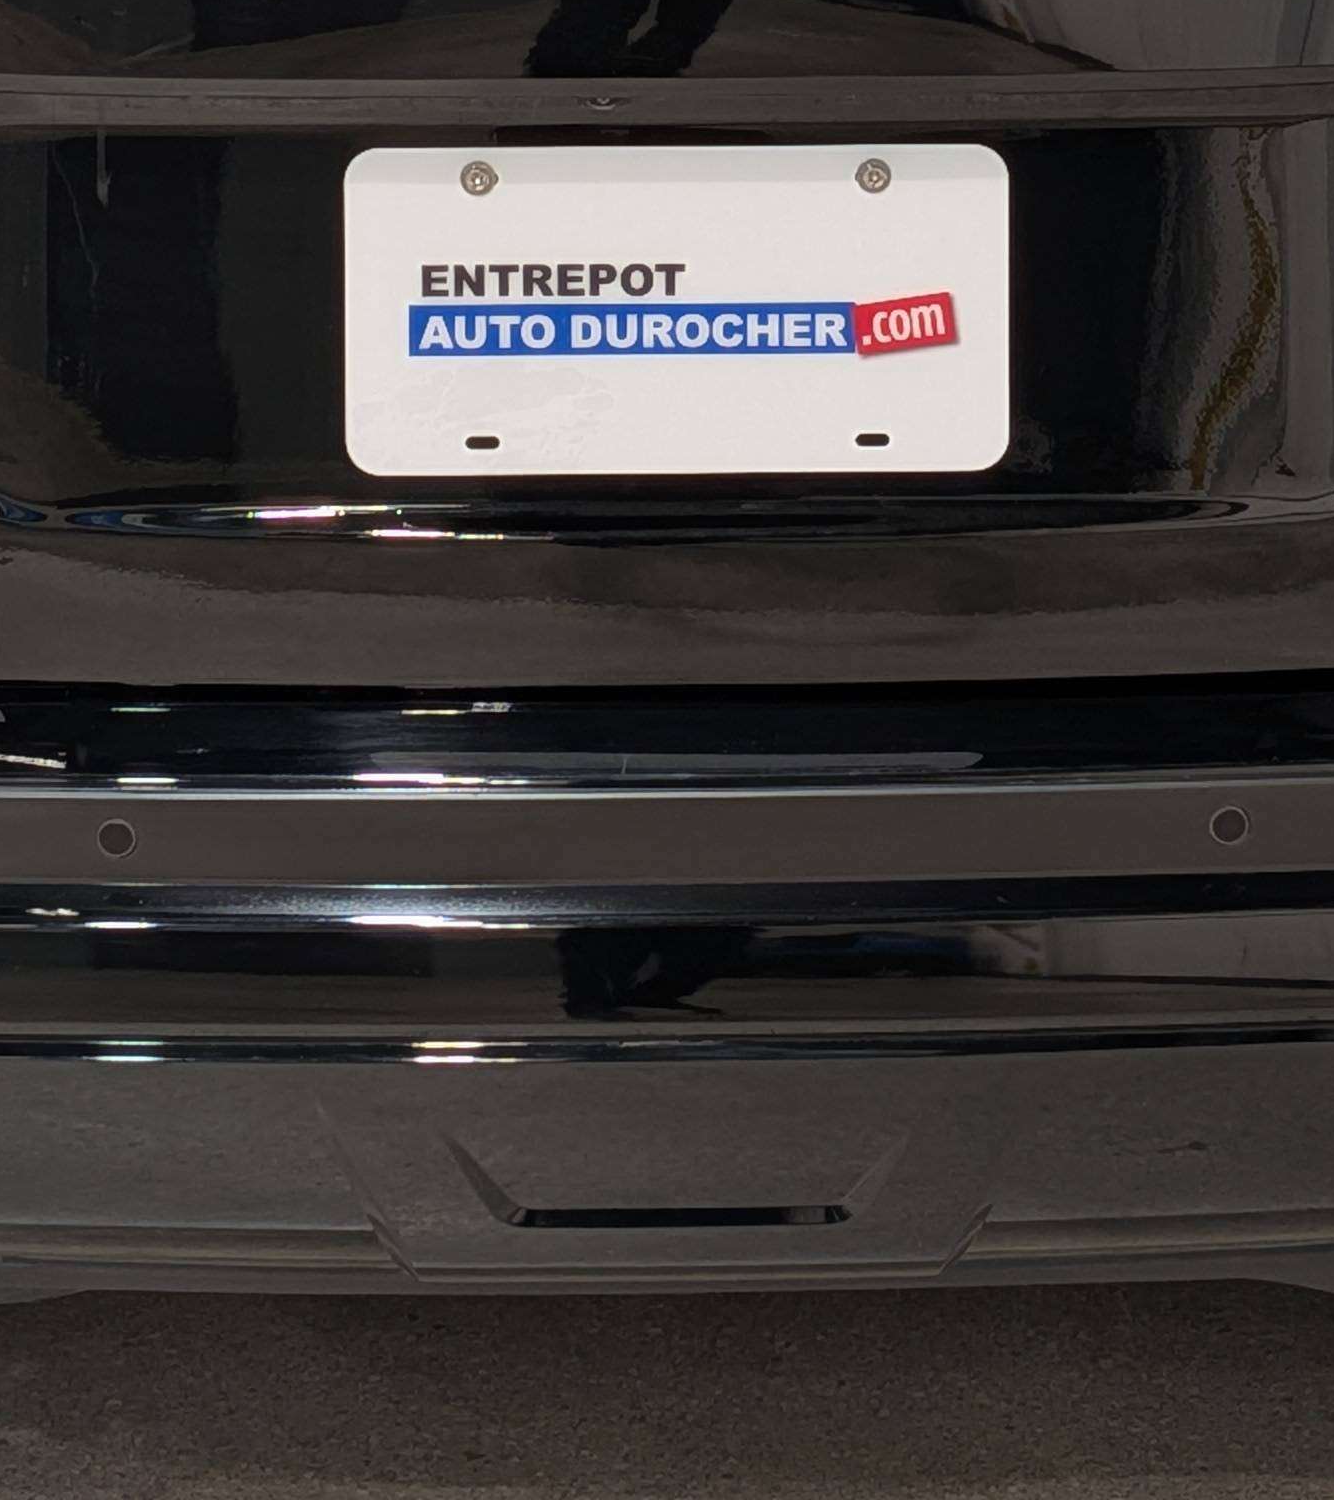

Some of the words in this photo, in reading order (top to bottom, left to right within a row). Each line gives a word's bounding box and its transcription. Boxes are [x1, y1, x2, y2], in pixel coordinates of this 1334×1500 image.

[421, 263, 686, 297] ENTREPOT
[419, 314, 556, 350] AUTO
[570, 312, 848, 349] DUROCHER
[862, 303, 946, 346] .com
